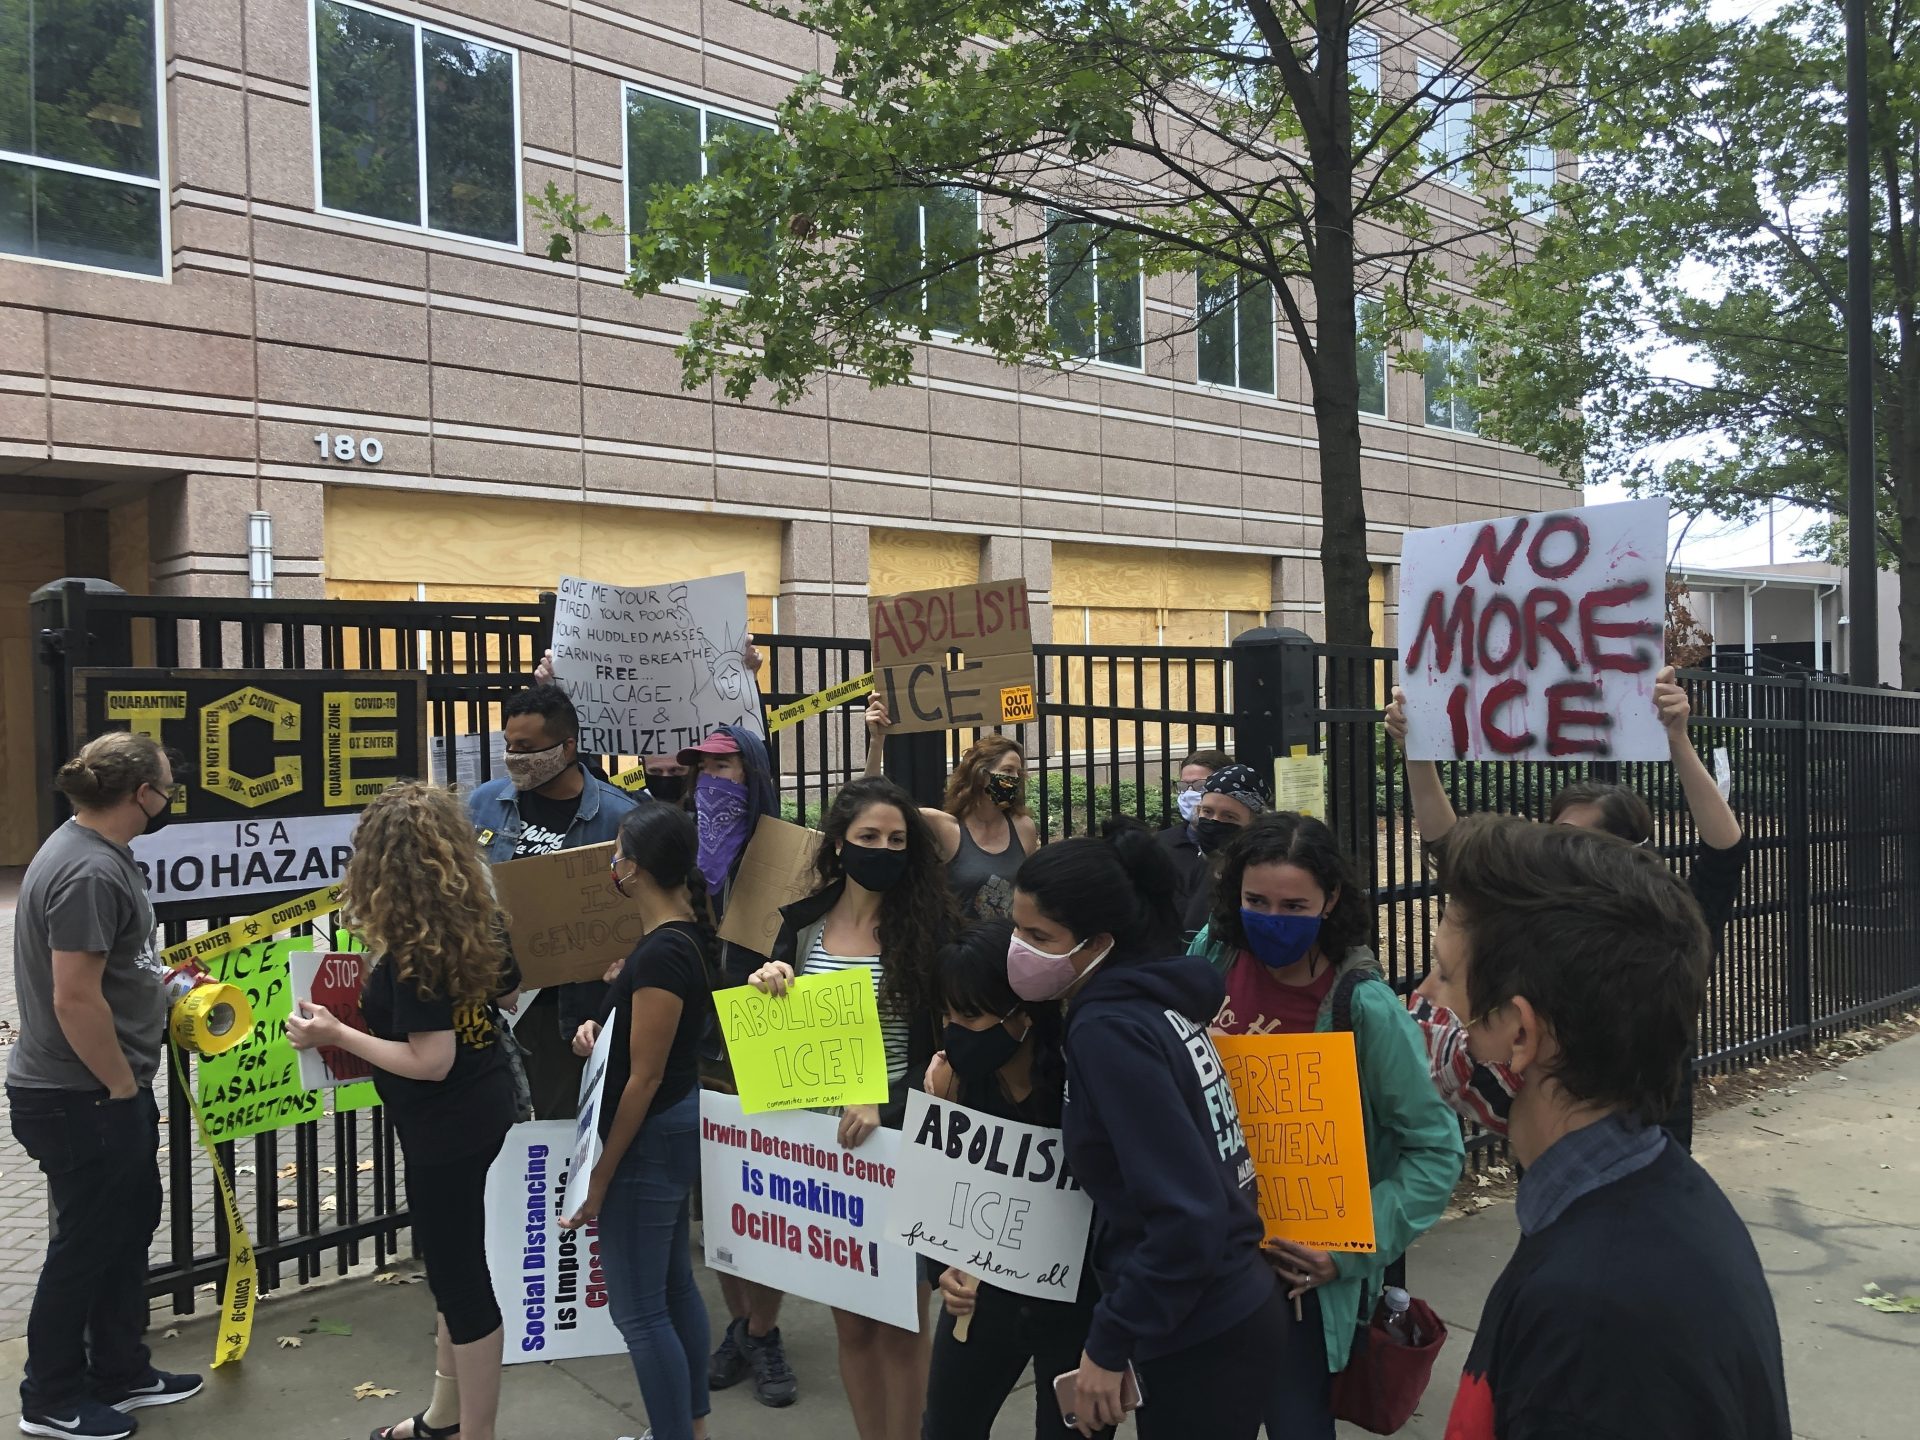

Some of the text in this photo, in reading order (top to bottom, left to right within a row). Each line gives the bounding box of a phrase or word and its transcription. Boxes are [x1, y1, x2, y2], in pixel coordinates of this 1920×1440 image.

[314, 432, 384, 464] 180
[1456, 514, 1590, 585] NO
[561, 578, 660, 606] GIVE ME YOUR
[600, 607, 635, 622] YOUR
[556, 621, 705, 644] YOUR HUDDLED MASSES
[873, 583, 1031, 663] ABOLISH
[1405, 580, 1664, 677] MORE
[553, 643, 712, 666] YEARNING TO BREATHE
[109, 695, 186, 710] QUARANTINE
[354, 697, 396, 710] COVID-19
[567, 679, 611, 705] WILL
[652, 706, 671, 723] &
[778, 703, 806, 722] COVID-19
[825, 682, 862, 702] QUARANTINE
[883, 660, 983, 726] ICE
[1004, 704, 1032, 718] NOW
[1005, 693, 1029, 707] OUT
[579, 726, 668, 755] ERILIZE
[1446, 676, 1614, 760] ICE
[206, 710, 220, 786] DO NOT ENTER
[328, 702, 342, 797] QUARANTINE ZONE
[363, 736, 395, 749] ENTER
[248, 773, 294, 798] COVID-19
[236, 821, 290, 847] IS A
[137, 845, 354, 893] BIOHAZAR
[171, 944, 193, 965] NOT
[195, 931, 232, 956] ENTER
[271, 899, 317, 925] COVID-19
[324, 958, 360, 990] STOP
[730, 982, 864, 1042] ABOLISH
[237, 1049, 268, 1073] FOR
[1221, 1051, 1324, 1115] FREE
[201, 1061, 294, 1109] LASALLE
[203, 1088, 319, 1137] CORRECTIONS
[702, 1117, 747, 1150] Irwin
[750, 1128, 839, 1174] Detention
[742, 1160, 864, 1228] is making
[949, 1181, 1031, 1250] ICE
[521, 1144, 550, 1352] Social Distancing
[731, 1202, 802, 1255] Ocilla
[901, 1221, 1070, 1289] free them all
[231, 1277, 251, 1322] COVID-19
[554, 1307, 577, 1331] is
